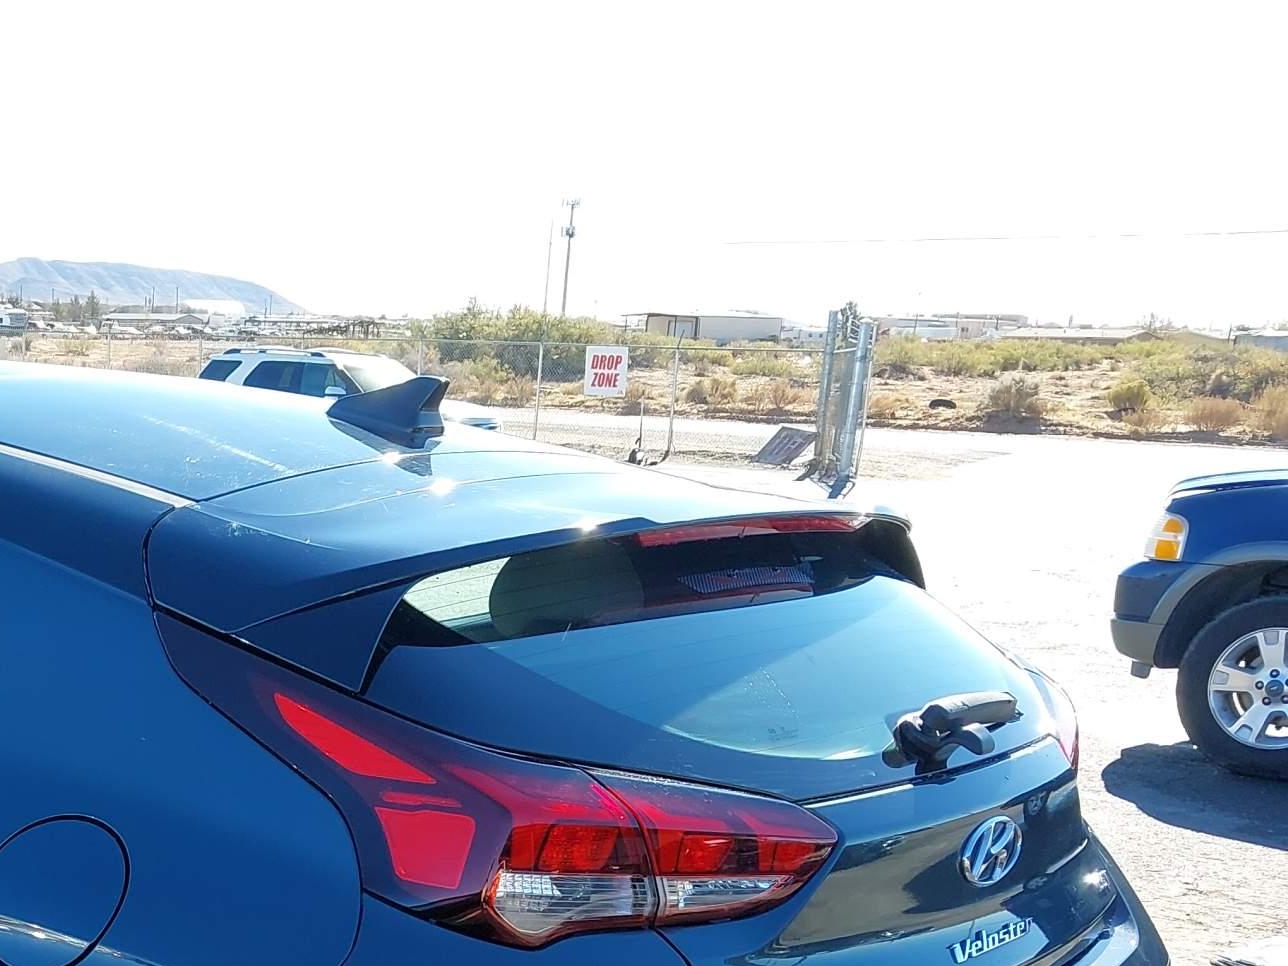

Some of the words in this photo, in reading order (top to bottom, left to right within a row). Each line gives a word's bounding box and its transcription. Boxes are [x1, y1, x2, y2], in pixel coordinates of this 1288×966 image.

[591, 354, 623, 370] DROP
[591, 372, 620, 388] ZONE
[948, 917, 1033, 964] Veloster
